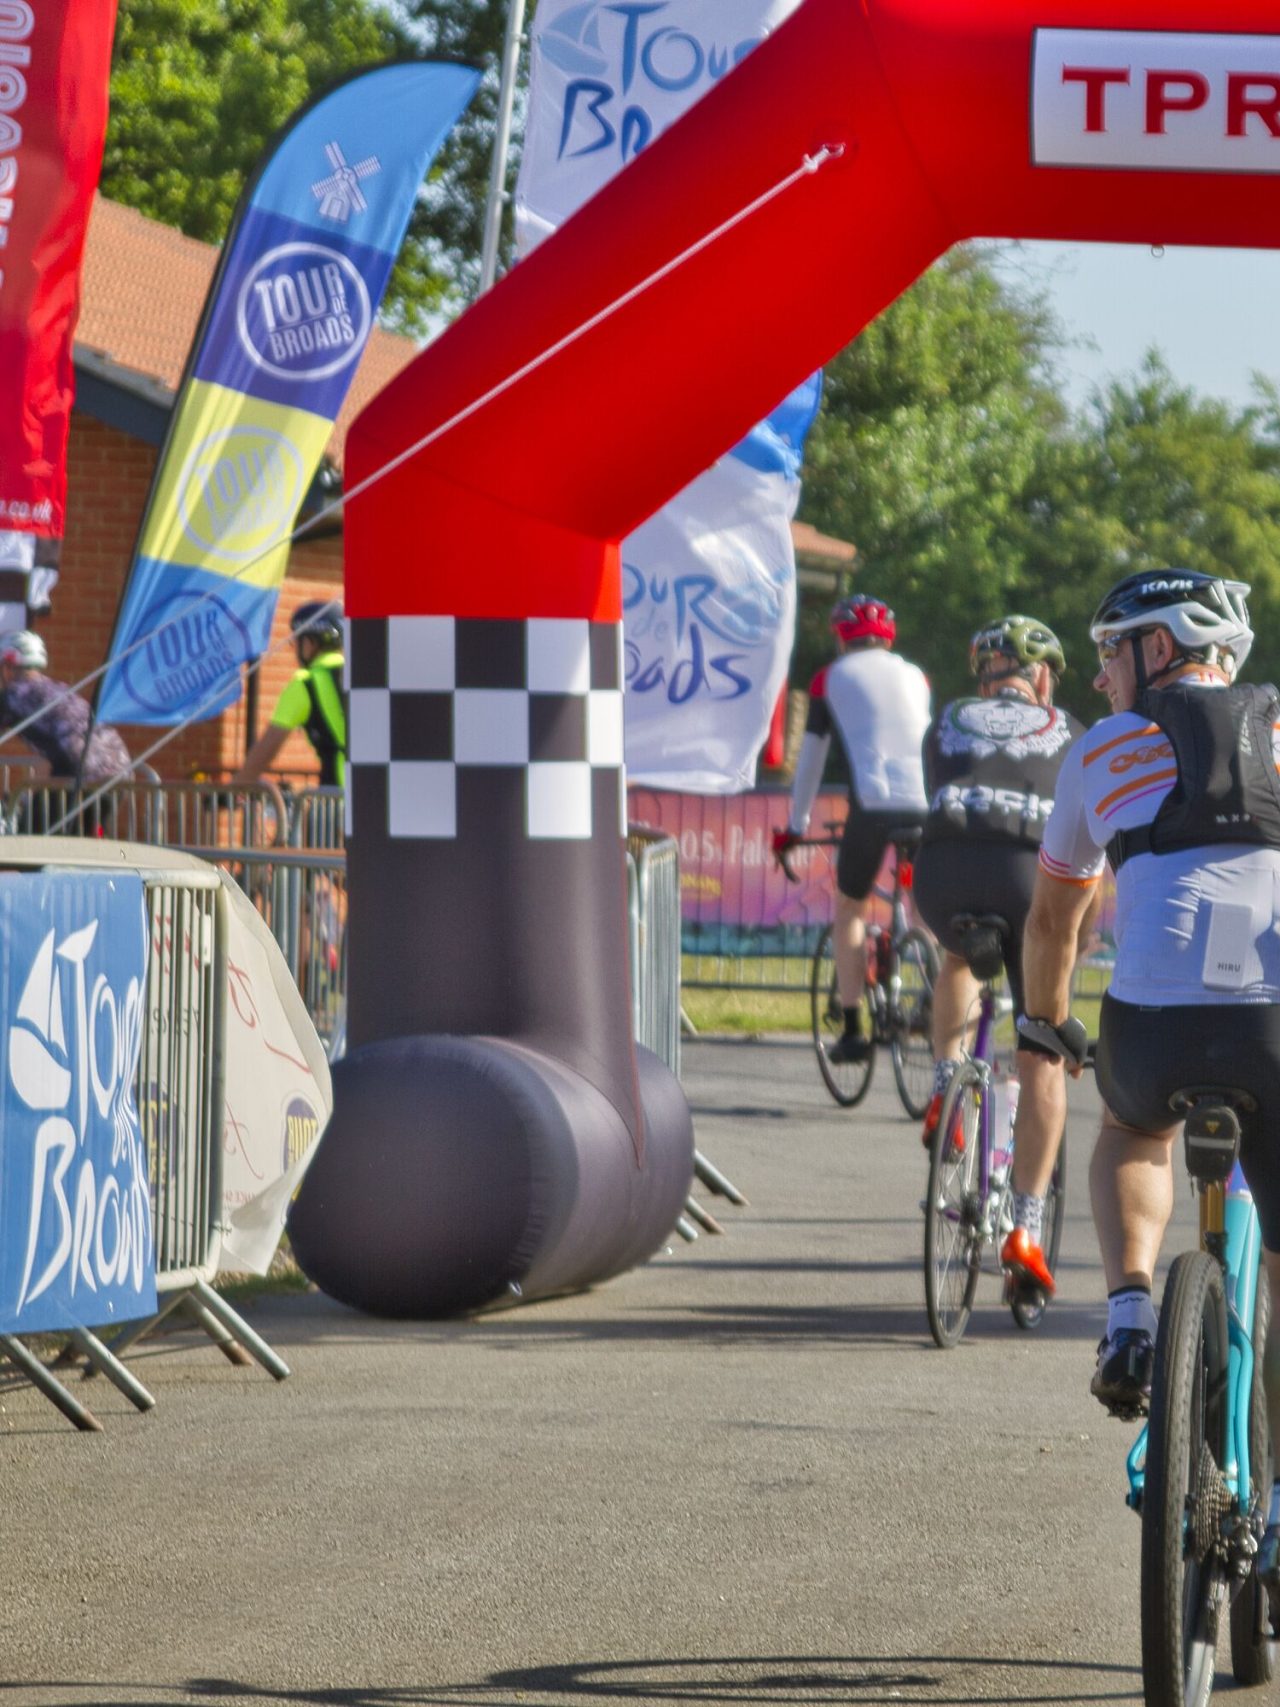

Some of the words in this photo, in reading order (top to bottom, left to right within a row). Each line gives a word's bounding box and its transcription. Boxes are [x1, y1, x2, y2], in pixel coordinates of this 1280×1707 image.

[254, 262, 346, 333] TOUR
[270, 313, 356, 362] BROADS
[1142, 579, 1194, 595] KASK
[1216, 962, 1241, 973] HIRU
